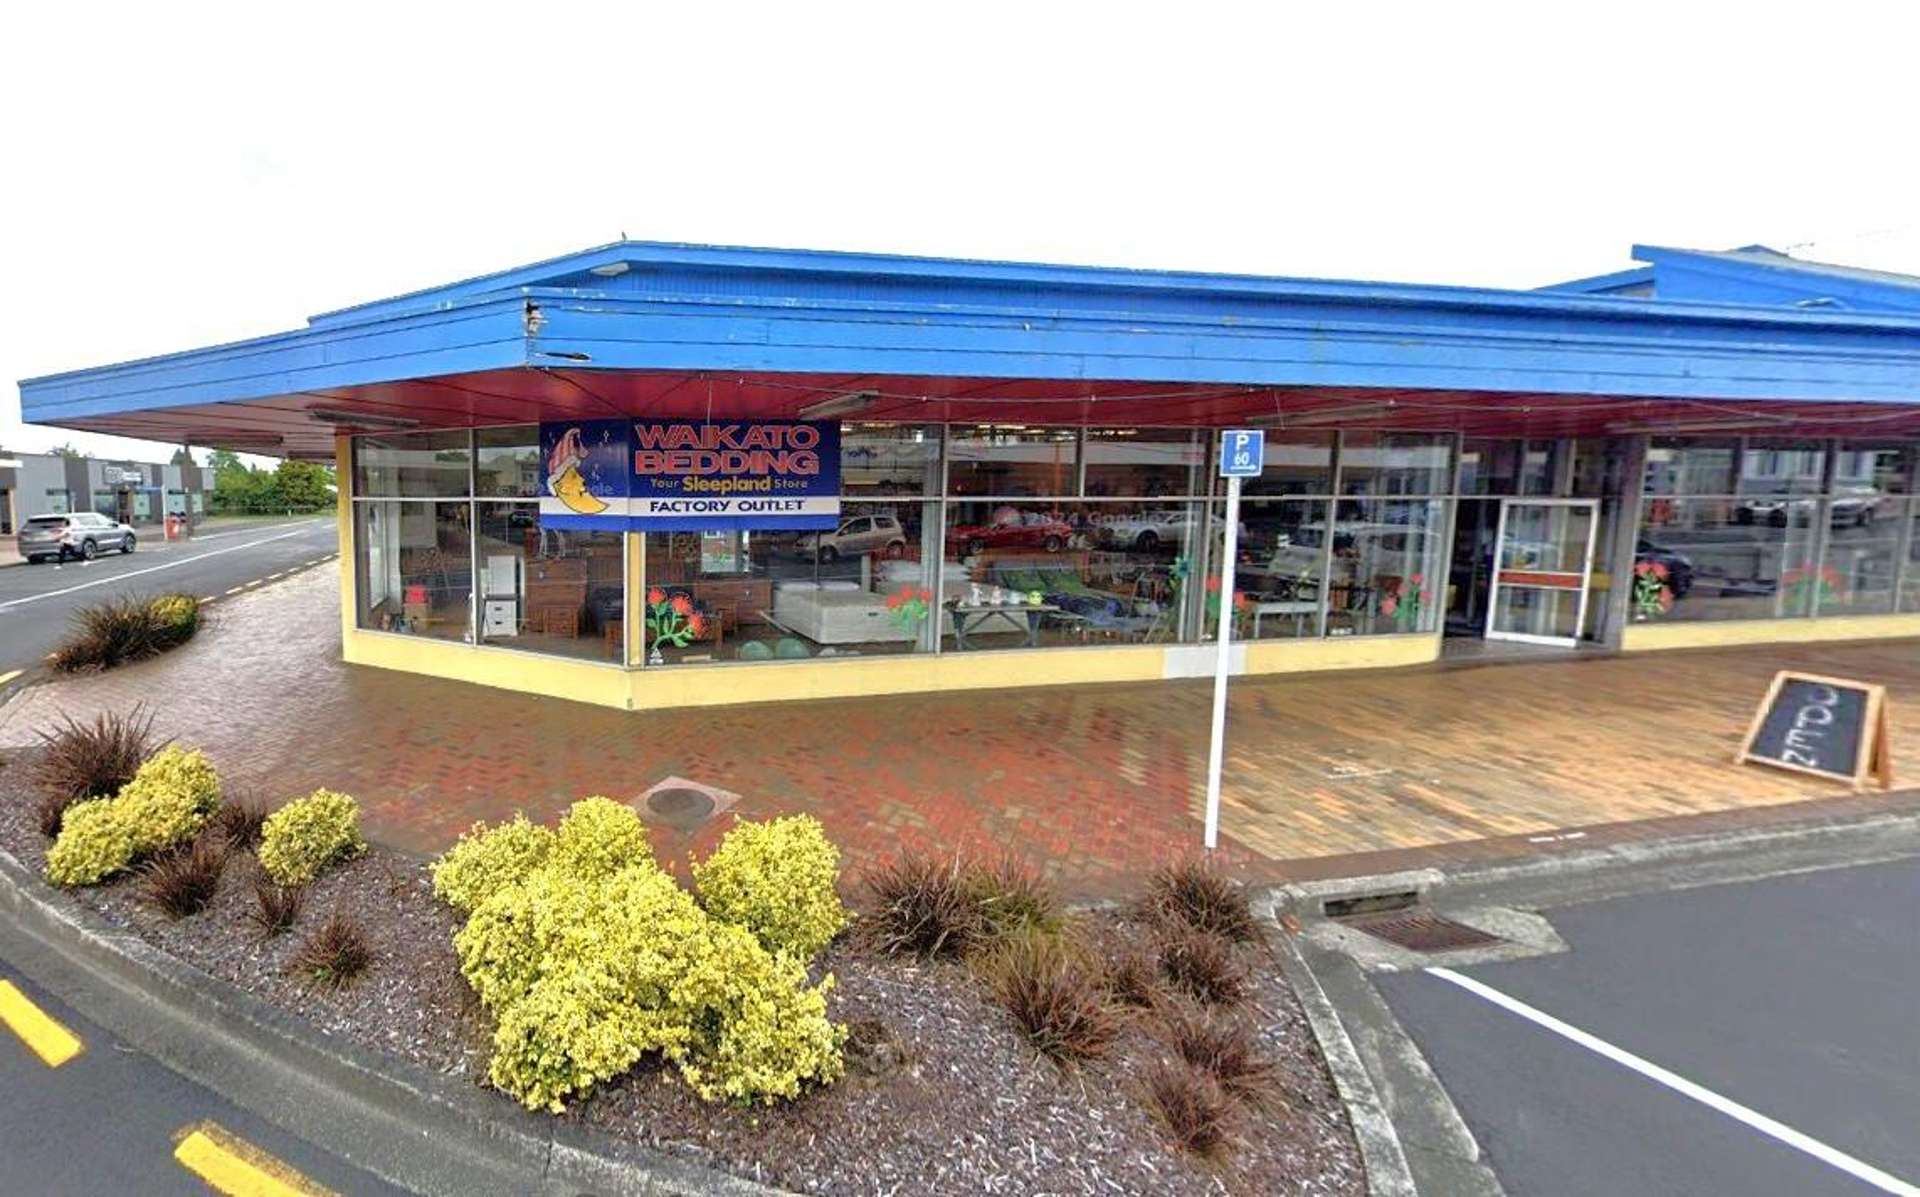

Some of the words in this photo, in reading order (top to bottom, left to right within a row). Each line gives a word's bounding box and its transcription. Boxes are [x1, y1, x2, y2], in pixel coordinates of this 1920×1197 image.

[635, 425, 820, 449] WAIKATO
[1236, 434, 1249, 450] P
[635, 450, 820, 475] BEDDING
[1233, 451, 1250, 465] 60
[650, 478, 680, 489] Your
[682, 475, 772, 495] Sleepland
[774, 478, 808, 489] Store
[649, 501, 730, 513] FACTORY
[738, 500, 805, 512] OUTLET
